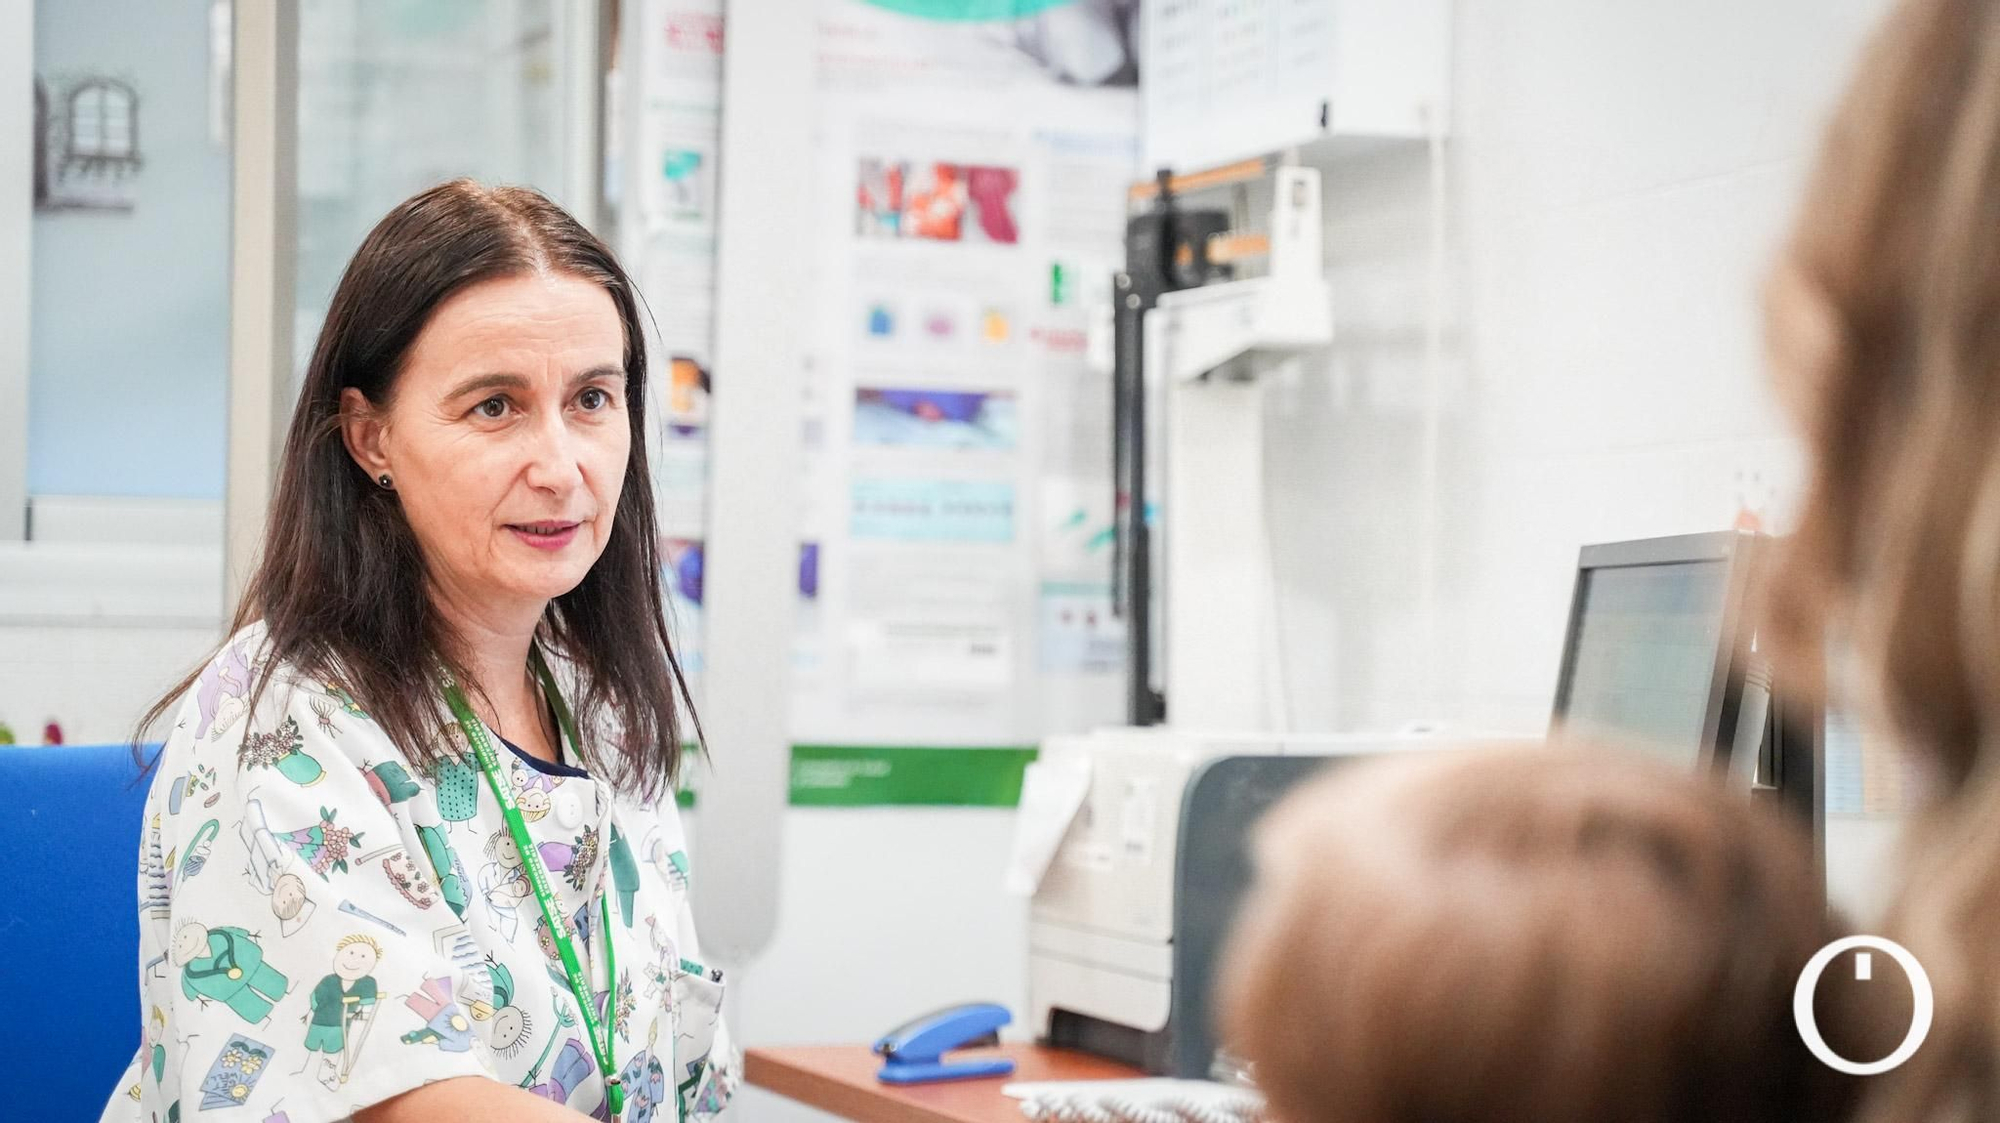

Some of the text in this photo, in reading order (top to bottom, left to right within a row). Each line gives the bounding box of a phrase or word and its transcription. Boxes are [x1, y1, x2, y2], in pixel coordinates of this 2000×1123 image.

[490, 768, 516, 810] SATSE
[528, 857, 546, 897] SINDICATO
[543, 896, 567, 939] SATSE
[212, 1079, 236, 1090] GET
